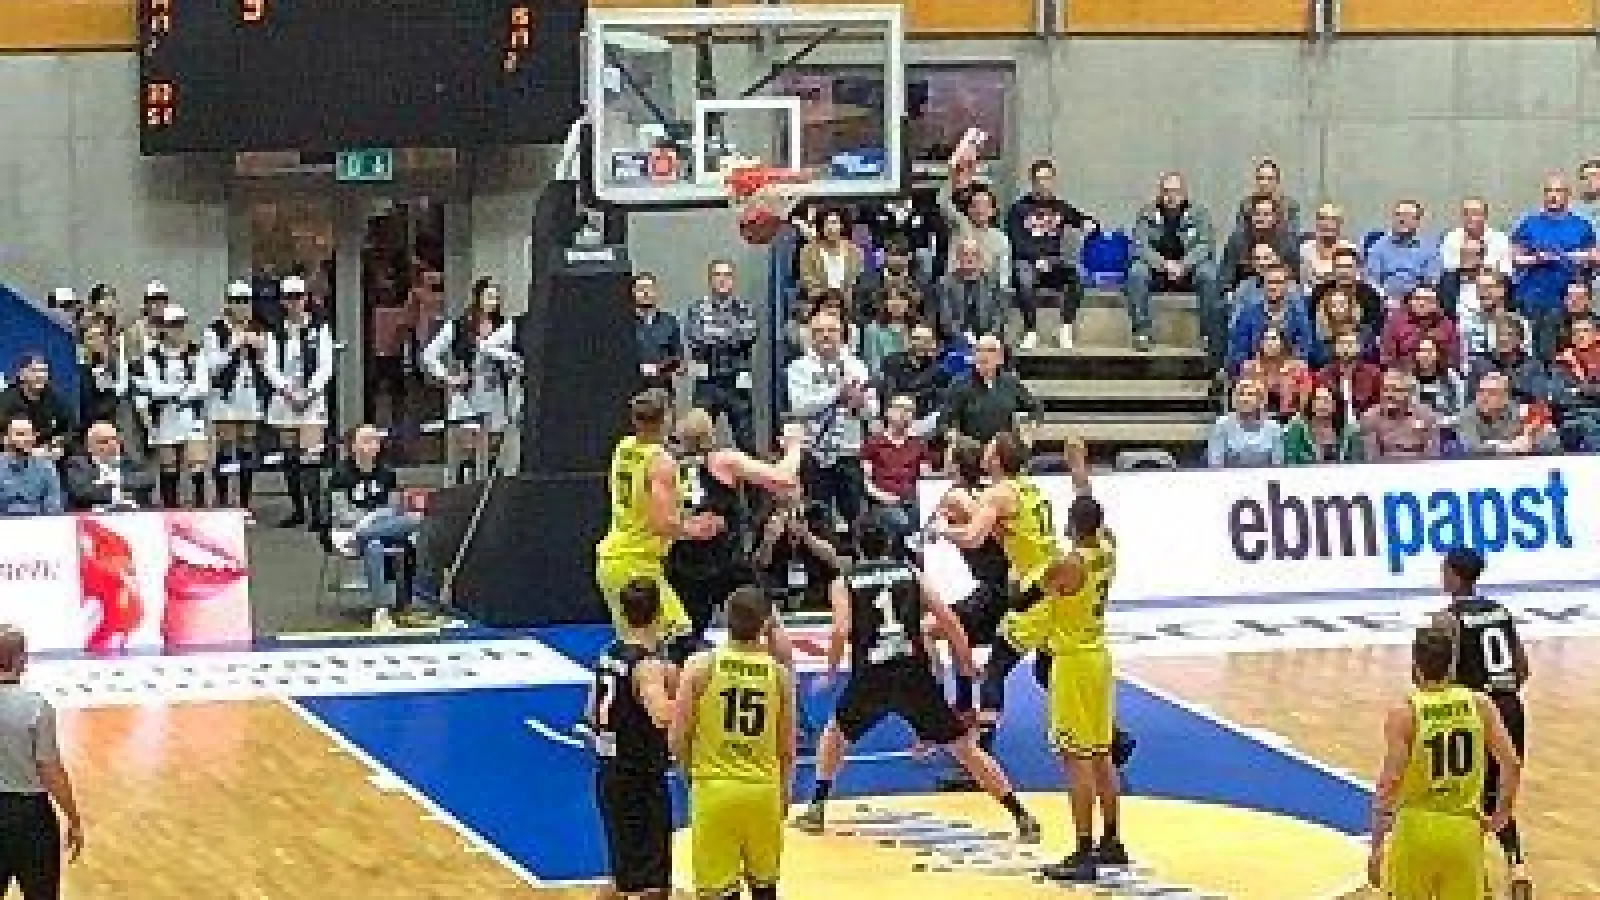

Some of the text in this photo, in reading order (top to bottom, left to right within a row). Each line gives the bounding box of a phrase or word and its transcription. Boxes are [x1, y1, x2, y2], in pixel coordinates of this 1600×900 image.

[1228, 468, 1573, 575] ebmpapst
[872, 588, 905, 635] 1
[1481, 627, 1513, 673] 0
[719, 687, 767, 737] 15
[1423, 727, 1474, 781] 10
